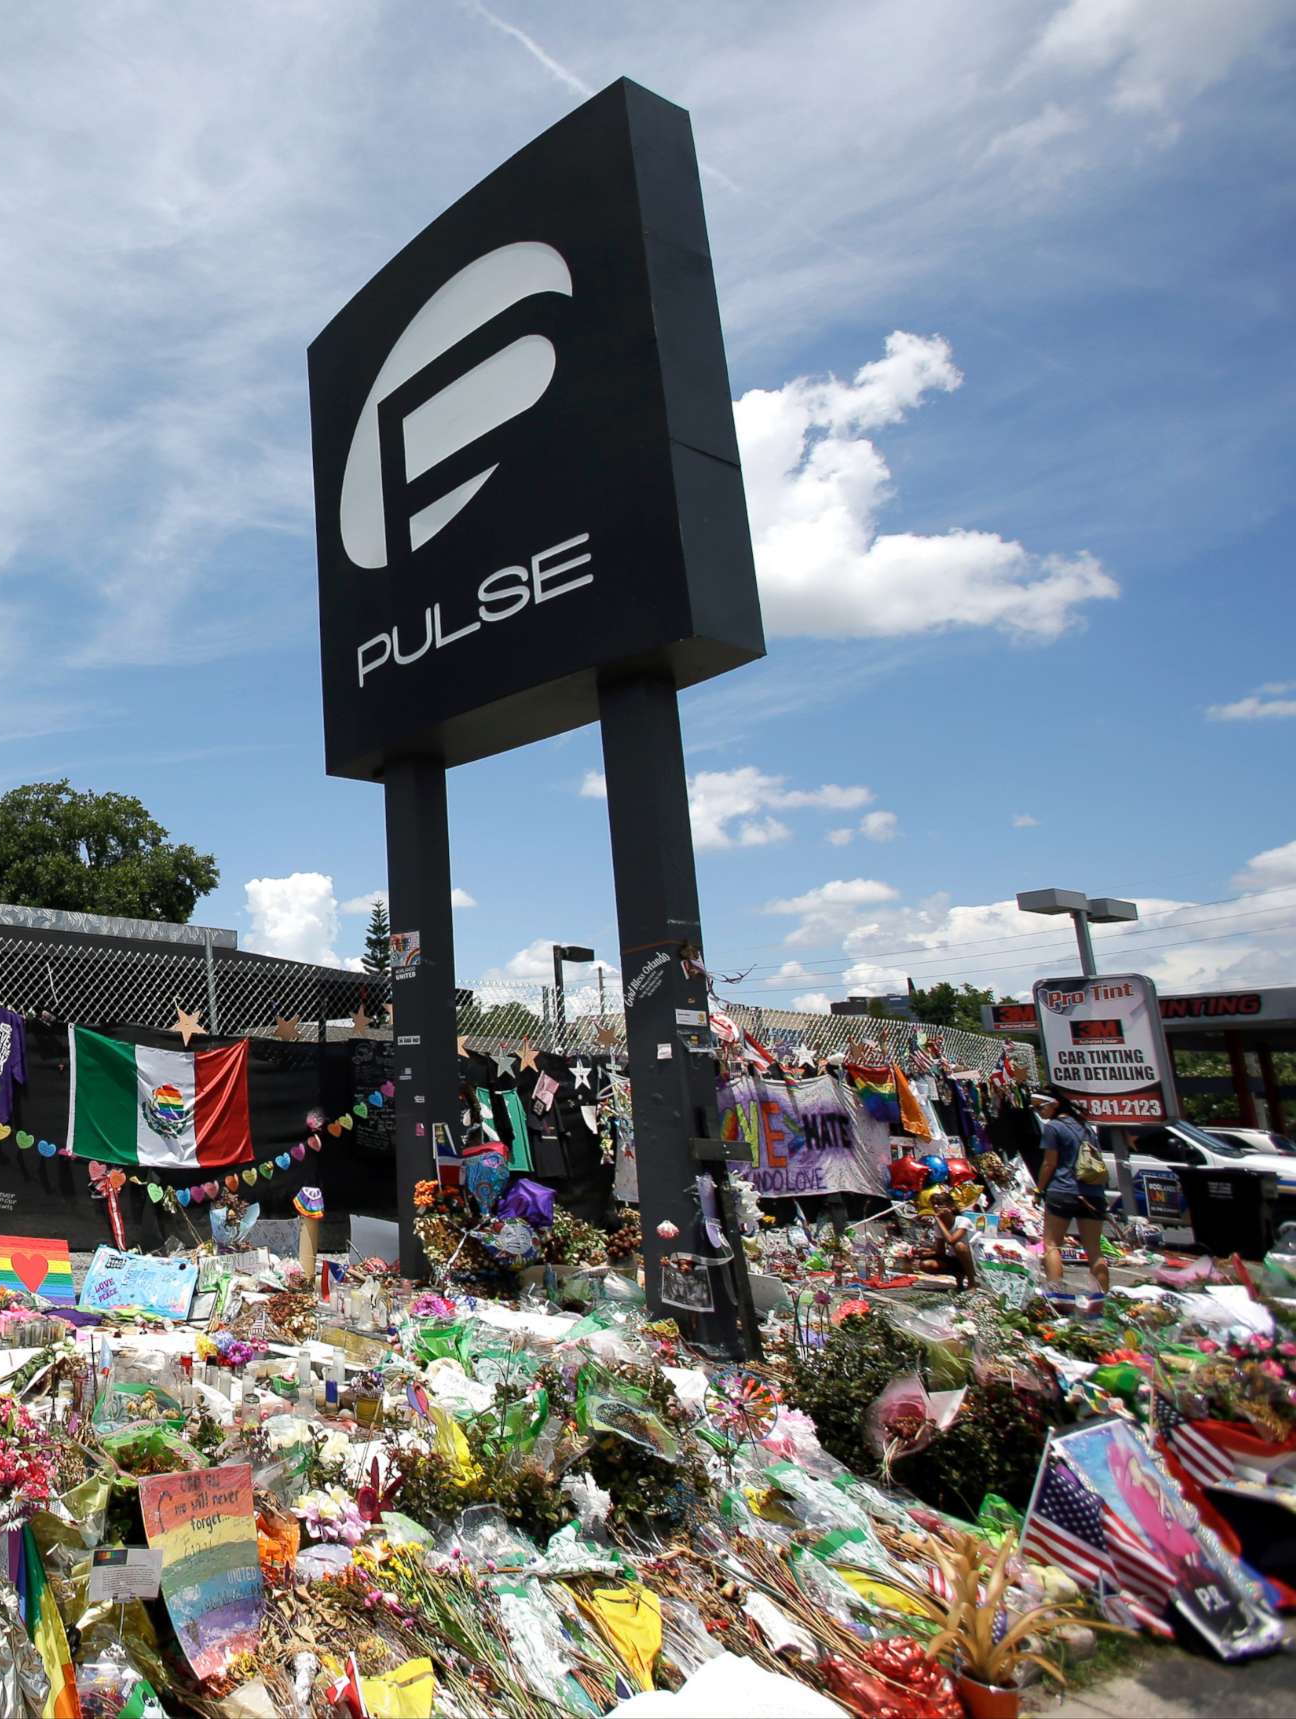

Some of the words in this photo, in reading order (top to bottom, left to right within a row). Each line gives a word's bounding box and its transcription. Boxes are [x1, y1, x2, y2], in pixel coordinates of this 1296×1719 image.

[357, 532, 594, 688] PULSE
[642, 951, 671, 975] Orlando
[1047, 990, 1086, 1009] Pro
[1090, 983, 1135, 1001] Tint
[1158, 994, 1260, 1019] INTING
[1078, 1020, 1118, 1037] 3M
[1058, 1050, 1085, 1064] CAR
[1088, 1049, 1144, 1064] TINTING
[1054, 1067, 1081, 1081] CAR
[1084, 1066, 1155, 1081] DETAILING
[1071, 1099, 1162, 1116] 7.841.2123
[785, 1167, 828, 1191] LOVE
[94, 1277, 114, 1294] LOVE
[97, 1287, 119, 1303] PEACE
[212, 1489, 240, 1505] never
